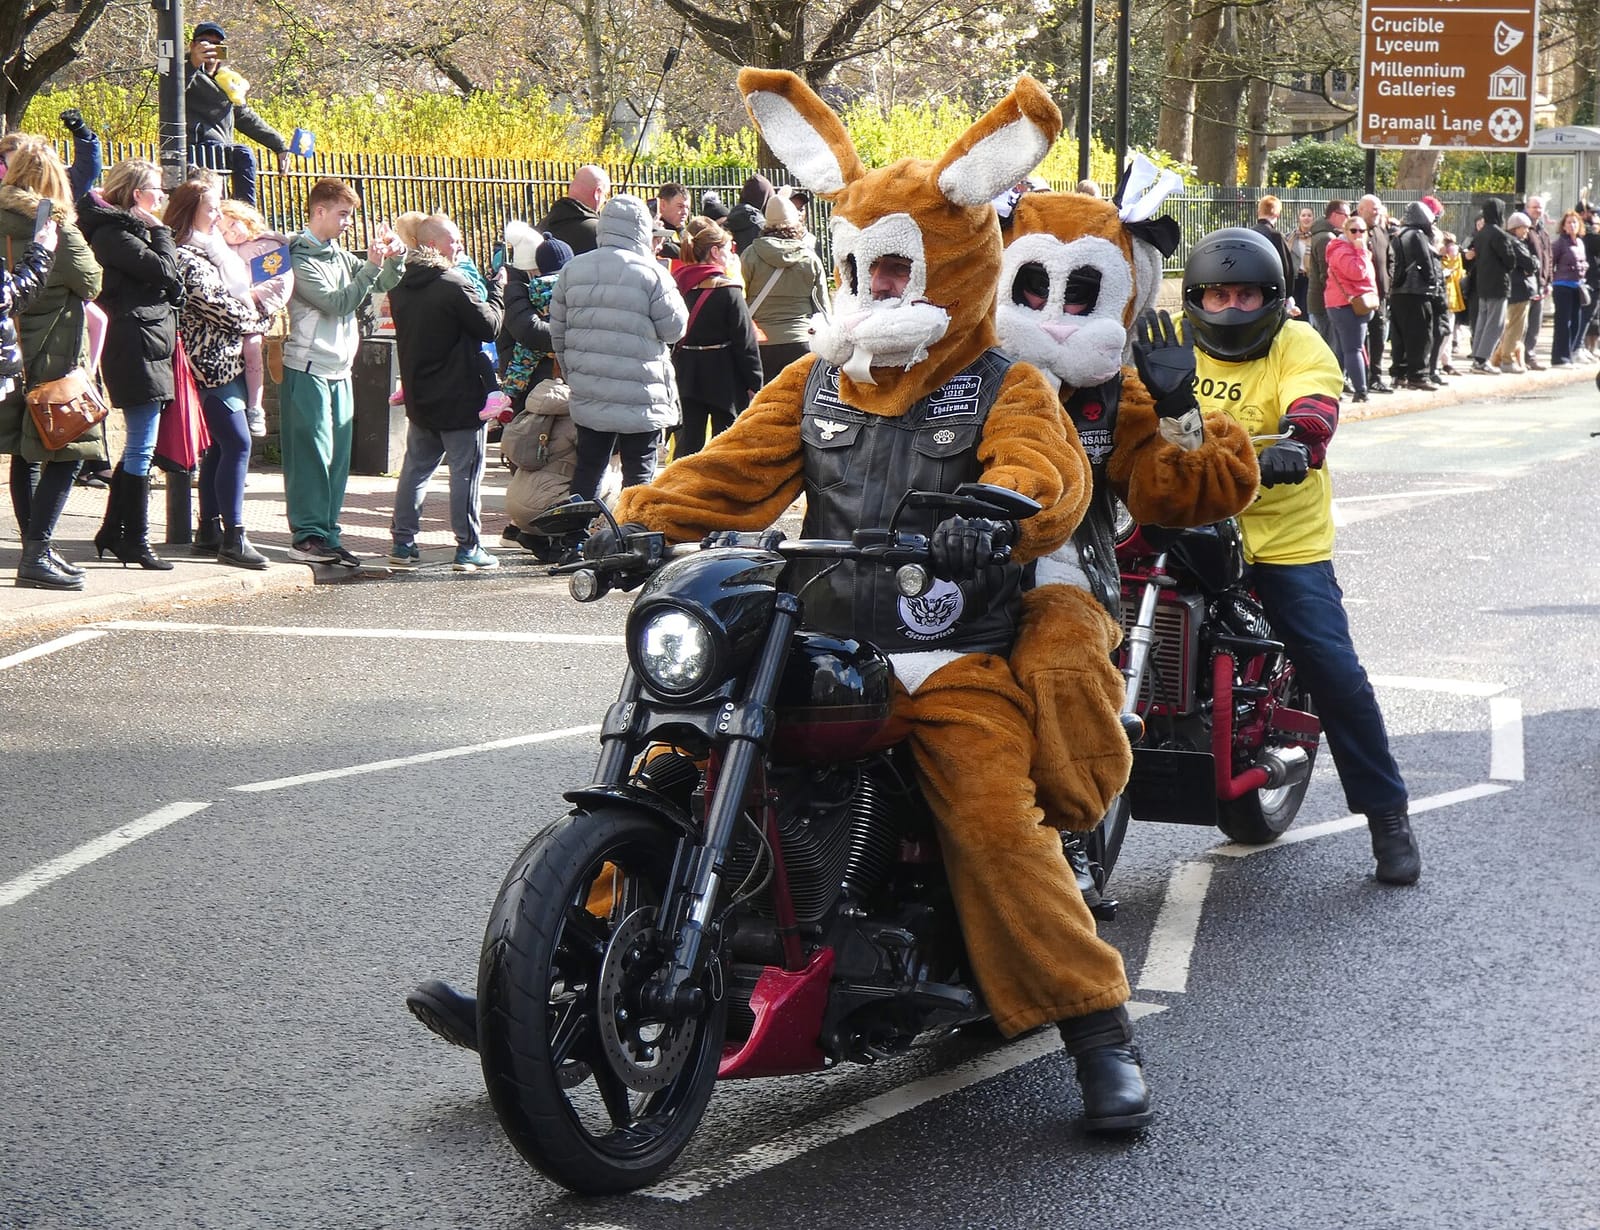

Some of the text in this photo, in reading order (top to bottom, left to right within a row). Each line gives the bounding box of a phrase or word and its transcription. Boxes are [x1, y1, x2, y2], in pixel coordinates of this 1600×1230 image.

[1371, 16, 1445, 33] Crucible
[161, 42, 167, 55] 1
[1376, 37, 1440, 55] Lyceum
[1370, 61, 1465, 79] Millennium
[1378, 80, 1456, 97] Galleries
[1368, 114, 1483, 131] Bramall Lane
[1192, 375, 1242, 401] 2026
[933, 404, 969, 415] Chairman
[1080, 435, 1112, 445] NSANE
[1081, 429, 1108, 437] CERTIFIED
